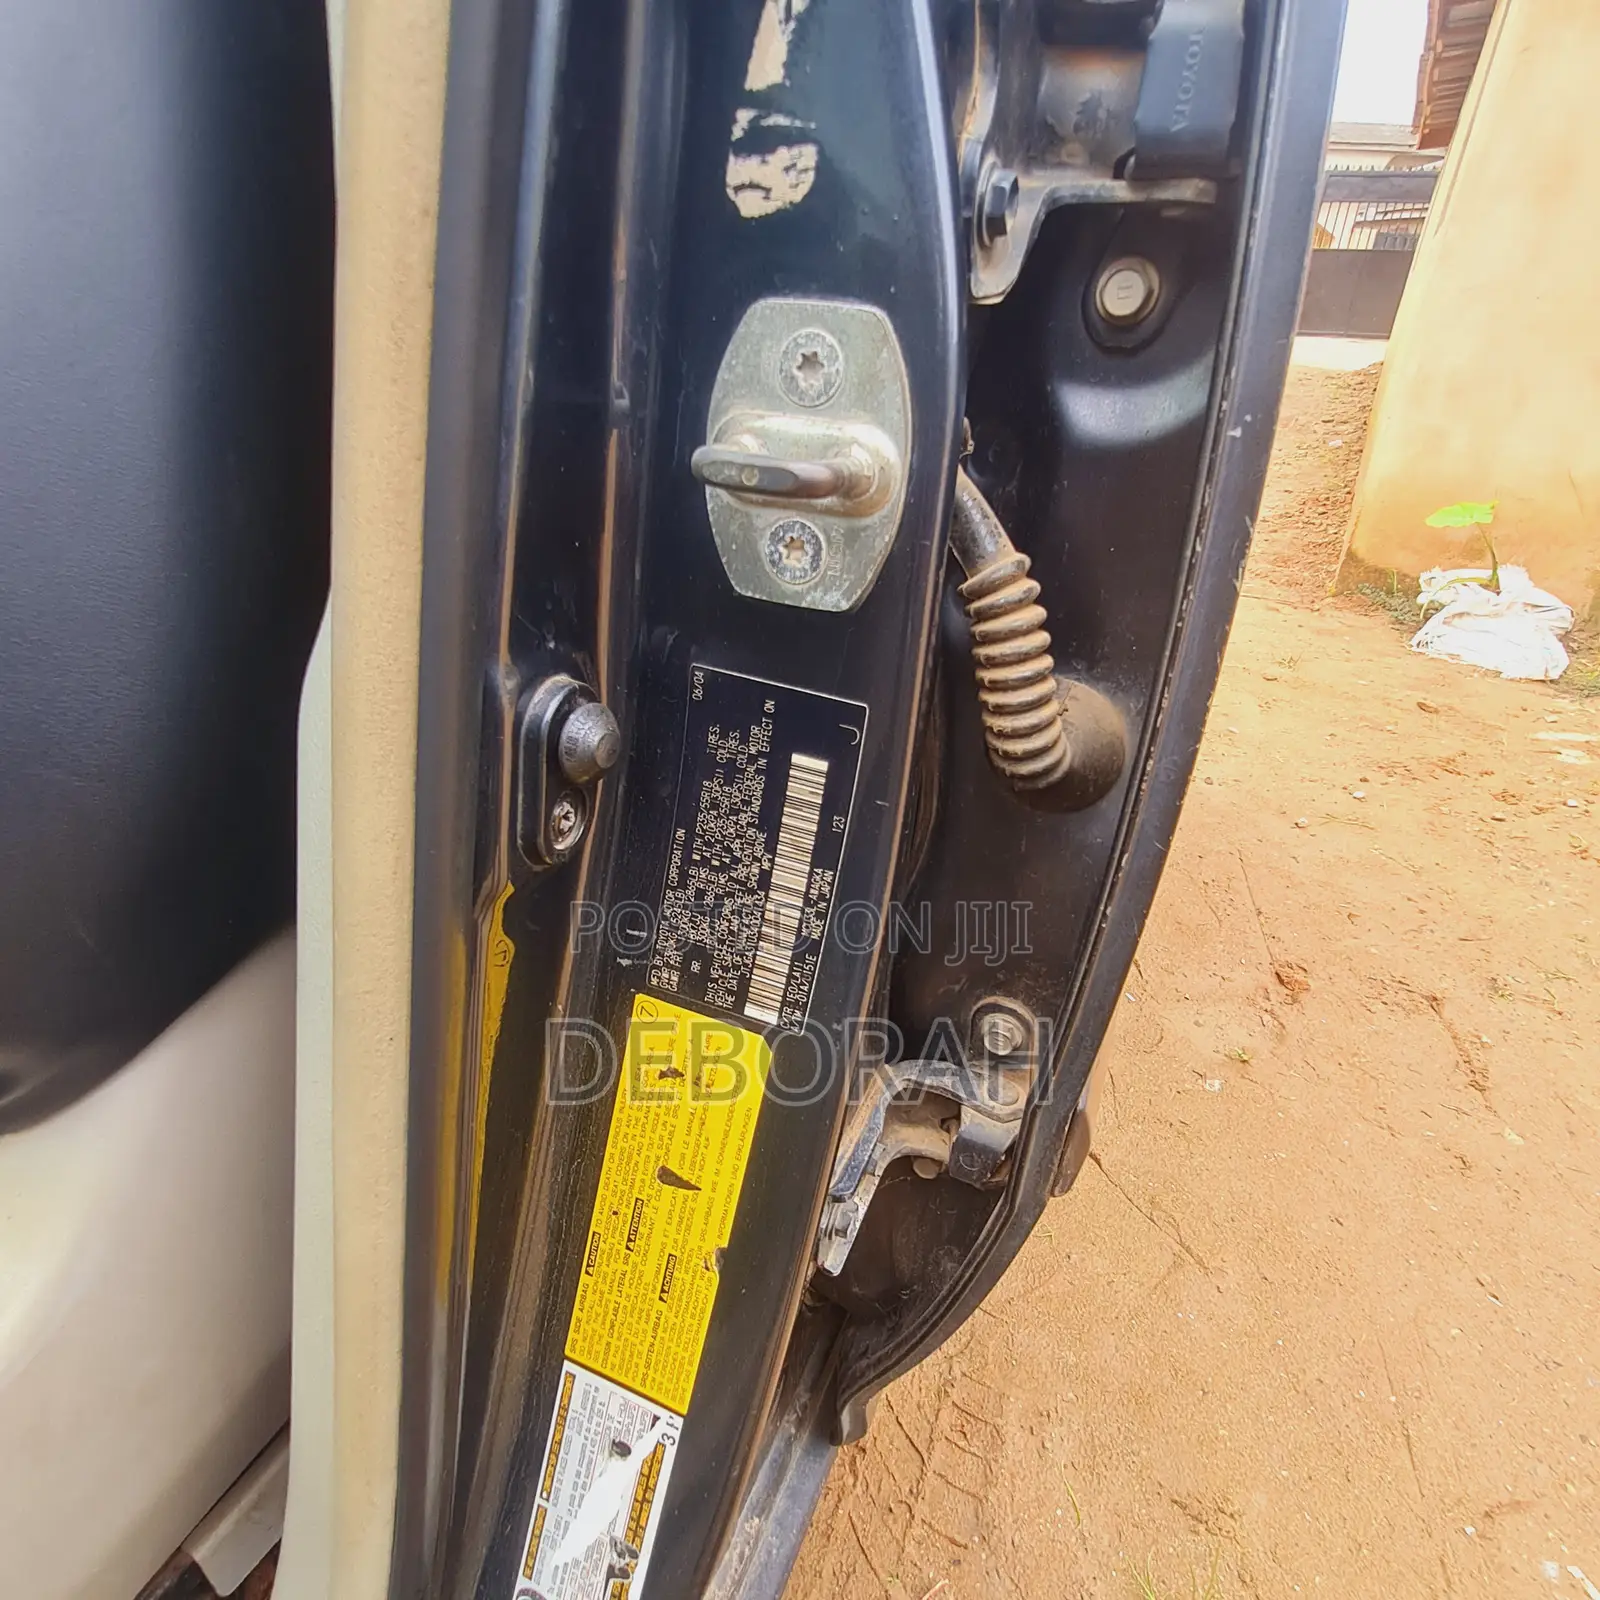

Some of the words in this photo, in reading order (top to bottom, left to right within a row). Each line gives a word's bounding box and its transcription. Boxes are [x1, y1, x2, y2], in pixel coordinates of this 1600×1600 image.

[1171, 29, 1206, 132] TOYOTA
[692, 670, 704, 701] 06/04
[763, 698, 776, 714] ON
[705, 721, 720, 755] TIRES.
[726, 726, 740, 759] TIRES.
[747, 724, 761, 755] MOTOR
[758, 716, 774, 752] EFFECT
[716, 735, 729, 763] COLD.
[735, 740, 749, 769] COLD.
[755, 756, 768, 769] IN
[740, 759, 757, 801] FEDERAL
[694, 779, 713, 835] P235/55R18
[714, 784, 733, 841] P235/55R18
[747, 773, 765, 824] STANDARDS
[704, 808, 719, 843] 210KPA
[723, 813, 738, 849] 210KPA
[731, 803, 750, 858] APPLICABLE
[830, 814, 845, 834] 123
[667, 826, 686, 886] CORPORATION
[691, 836, 704, 861] WITH
[701, 845, 713, 858] AT
[709, 842, 723, 867] WITH
[720, 851, 732, 864] AT
[737, 826, 757, 882] PREVENTION
[760, 850, 773, 871] MPV
[683, 864, 699, 905] (2865LB)
[696, 862, 710, 889] RIMS.
[715, 867, 729, 895] RIMS.
[728, 861, 740, 879] ALL
[746, 859, 762, 890] SHOWN
[818, 868, 834, 899] JAPAN
[702, 870, 719, 910] (2865LB)
[725, 880, 737, 893] TO
[731, 883, 746, 912] THEFT
[661, 887, 675, 917] MOTOR
[815, 899, 827, 913] IN
[677, 908, 692, 941] 1300KG
[695, 914, 711, 947] 1300KG
[717, 895, 734, 940] CONFORMS
[728, 913, 741, 932] AND
[734, 891, 756, 950] MANUFACTURE
[809, 916, 824, 941] MADE
[655, 918, 671, 951] TOYOTA
[652, 953, 664, 966] BY
[690, 957, 702, 973] RR.
[709, 941, 726, 979] VEHICLE
[721, 933, 737, 968] SAFETY
[731, 952, 744, 966] OF
[649, 967, 661, 986] MFD
[658, 966, 672, 989] GVWR
[668, 969, 680, 992] GAWR
[713, 969, 730, 1007] VEHICLE
[726, 966, 741, 991] DATE
[703, 980, 718, 1004] THIS
[722, 992, 736, 1010] THE
[640, 1005, 654, 1018] 7
[617, 1086, 628, 1114] INJURY
[610, 1116, 622, 1150] SERIOUS
[608, 1151, 616, 1164] OR
[602, 1165, 613, 1192] DEATH
[597, 1193, 607, 1216] AVOID
[594, 1217, 602, 1229] TO
[628, 1198, 643, 1241] ATTENTION
[587, 1232, 600, 1266] CAUTION
[662, 1254, 676, 1292] ACHTUNG
[576, 1280, 589, 1313] AIRBAG
[572, 1314, 583, 1335] SIDE
[568, 1336, 578, 1354] SRS
[660, 1432, 676, 1446] 3
